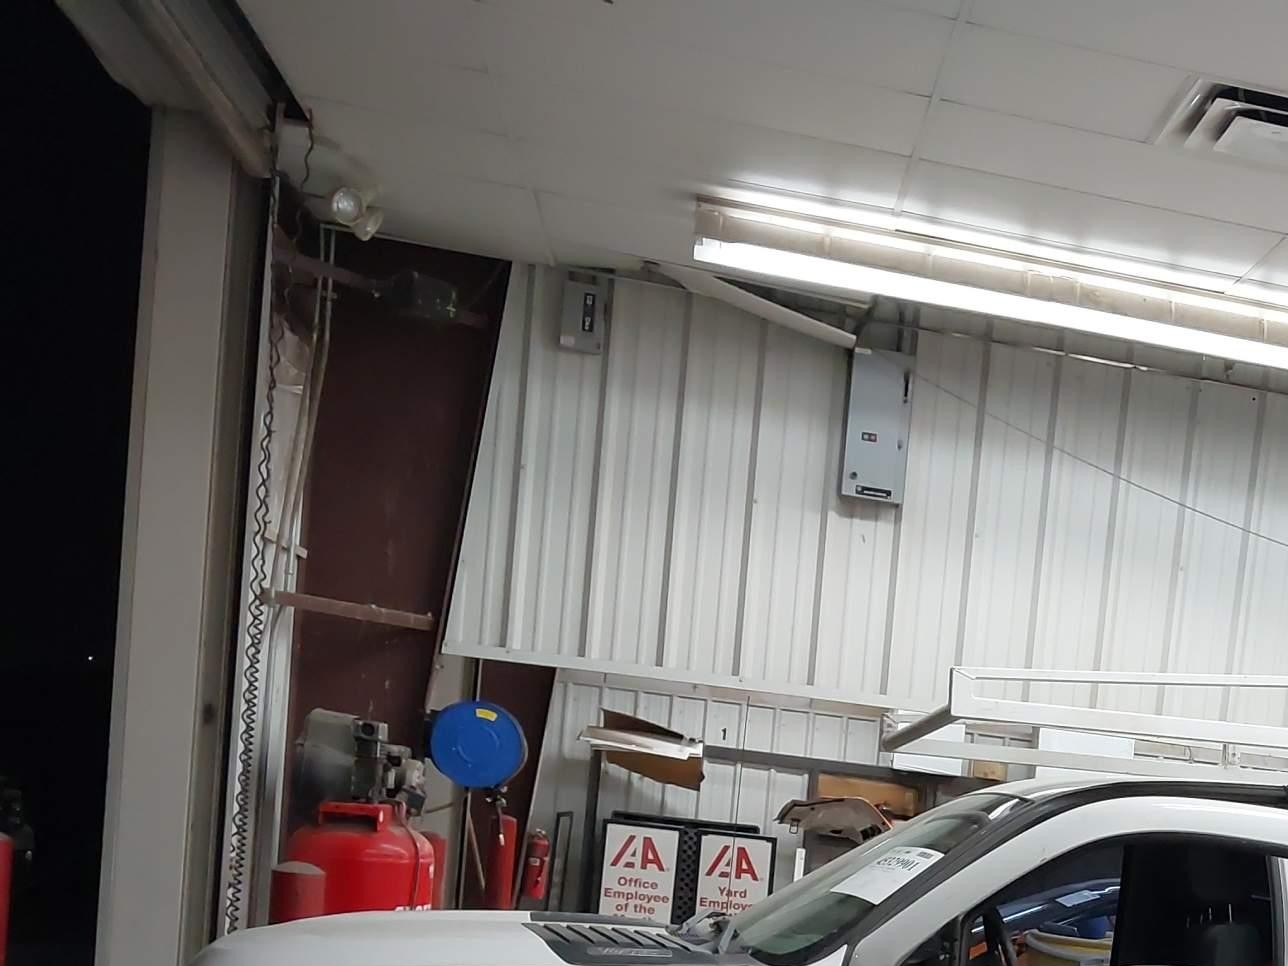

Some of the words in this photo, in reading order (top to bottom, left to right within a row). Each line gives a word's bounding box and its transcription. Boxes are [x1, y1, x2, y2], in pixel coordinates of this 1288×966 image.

[721, 727, 727, 741] 1
[617, 876, 659, 890] Office
[603, 887, 670, 905] Employee
[718, 886, 747, 899] Yard
[615, 902, 629, 912] of
[633, 903, 656, 915] the
[699, 897, 753, 912] Employ
